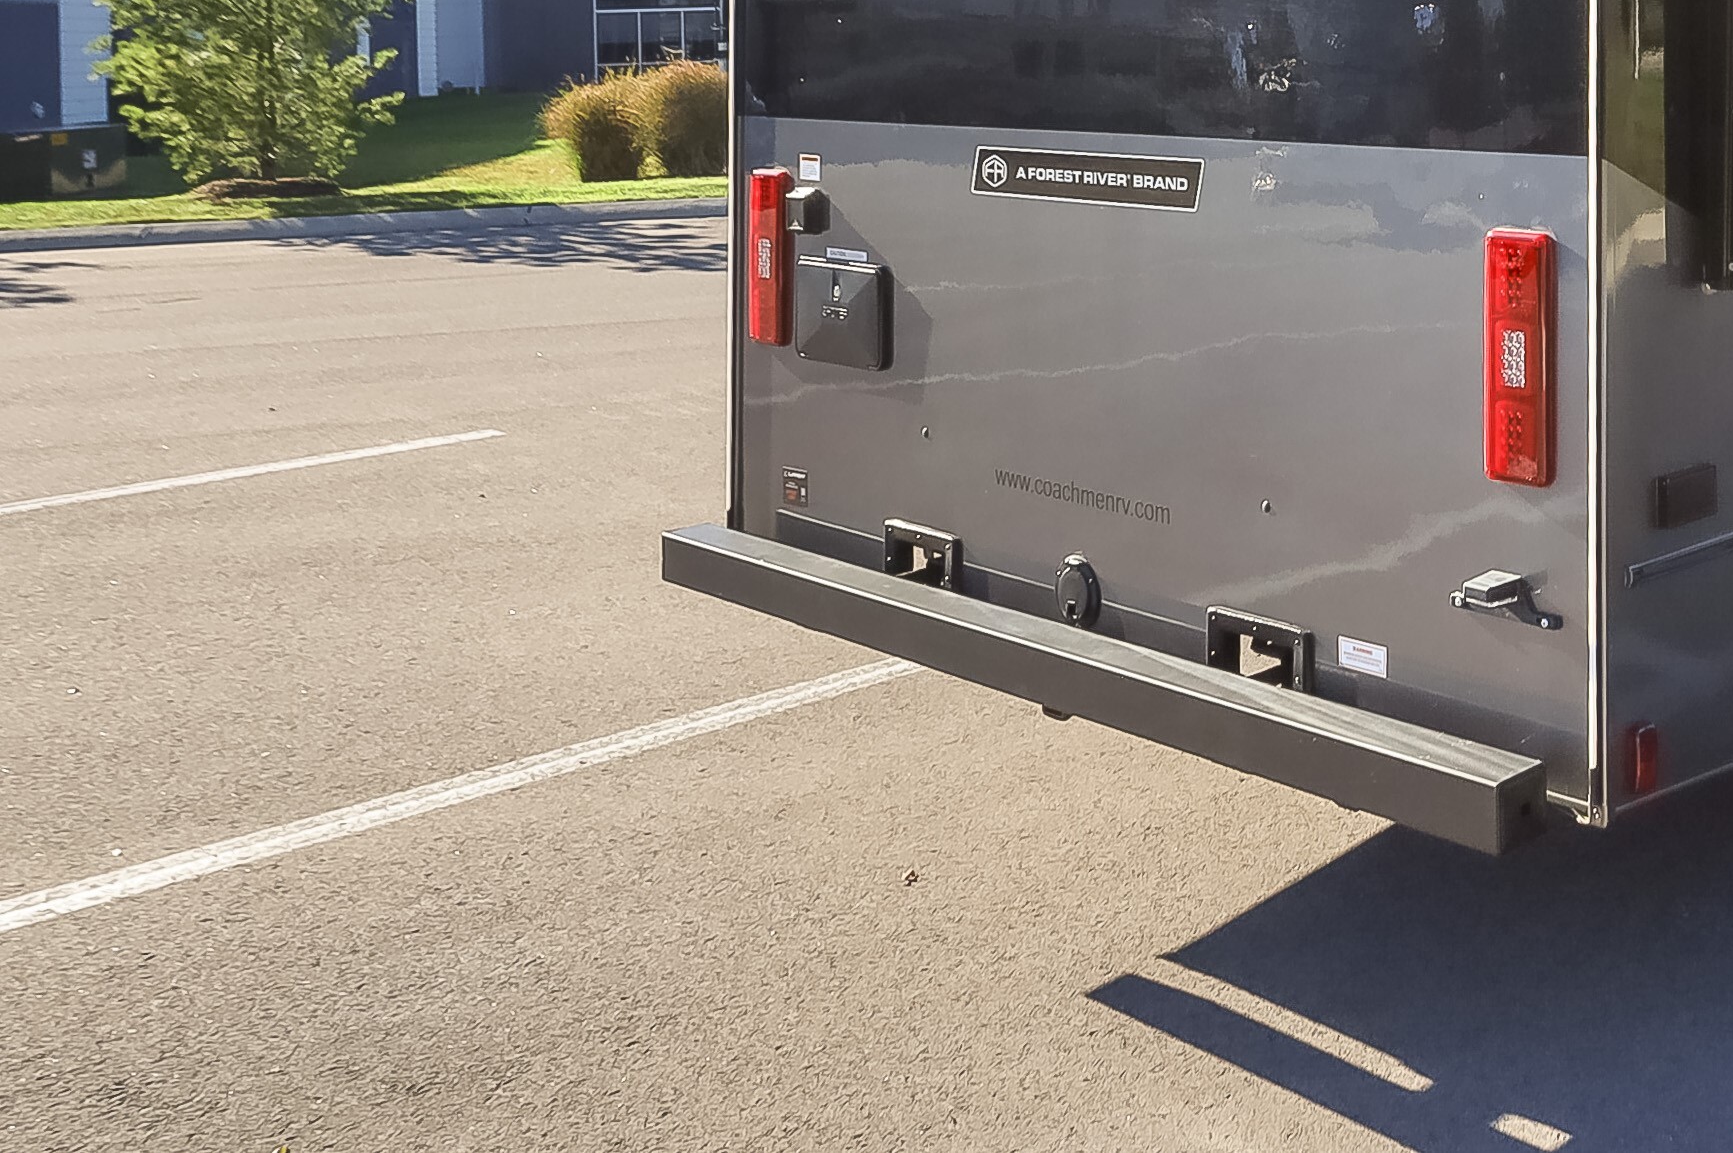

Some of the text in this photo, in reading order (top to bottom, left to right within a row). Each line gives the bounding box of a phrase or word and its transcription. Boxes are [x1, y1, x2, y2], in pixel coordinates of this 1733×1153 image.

[1015, 166, 1027, 180] A
[1028, 167, 1081, 184] FOREST
[1132, 174, 1188, 191] BRAND
[994, 468, 1171, 525] www.coachmenrv.com
